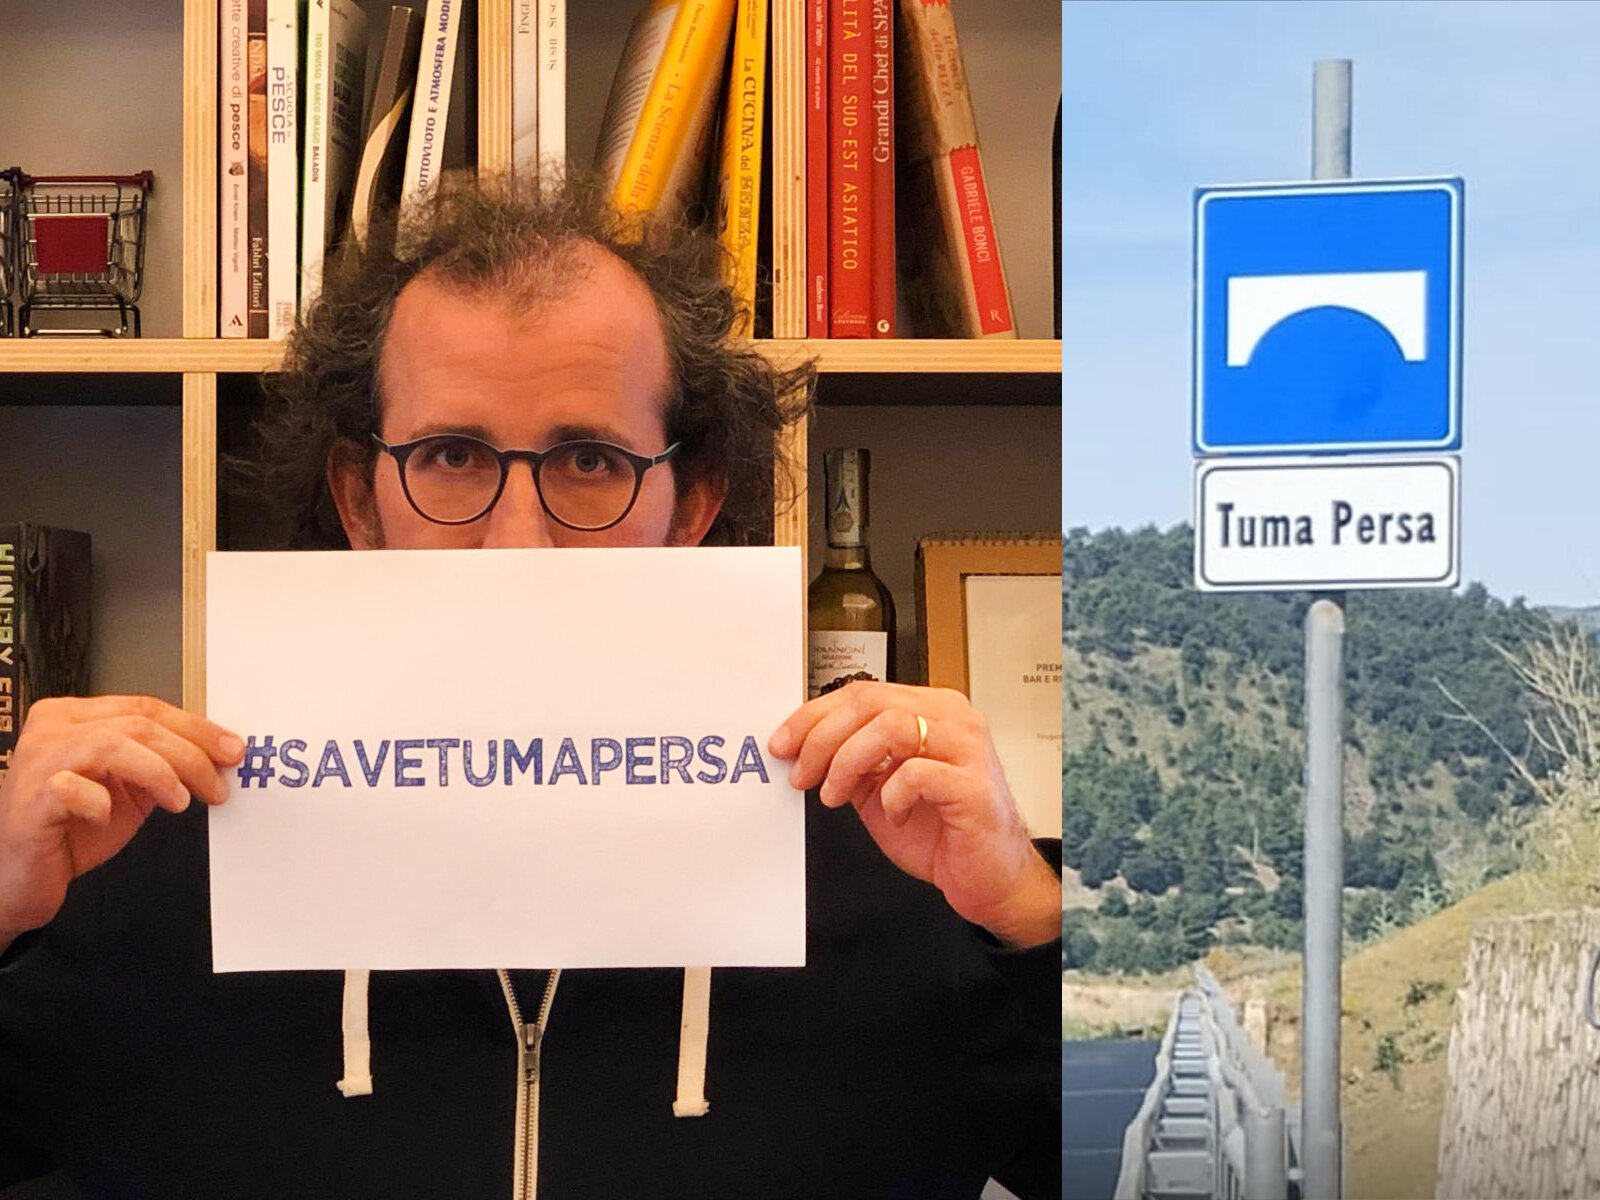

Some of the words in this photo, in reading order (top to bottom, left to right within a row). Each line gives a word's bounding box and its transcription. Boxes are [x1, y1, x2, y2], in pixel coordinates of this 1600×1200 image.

[231, 26, 242, 81] creative
[744, 58, 755, 72] La
[874, 35, 888, 49] di
[231, 85, 242, 99] di
[429, 36, 447, 103] ATMOSFERA
[664, 83, 681, 101] La
[842, 53, 858, 85] DEL
[872, 52, 889, 95] Chef
[229, 103, 241, 151] pesce
[272, 66, 285, 145] PESCE
[286, 82, 294, 128] SCUOLA
[428, 106, 438, 114] E
[741, 76, 757, 152] CUCINA
[644, 106, 674, 161] Scienza
[842, 95, 858, 171] SUD-EST
[872, 98, 890, 163] Grandi
[311, 145, 320, 183] BALADIN
[416, 117, 437, 194] SOTTOVUOTO
[740, 156, 751, 171] del
[630, 166, 653, 199] della
[842, 182, 858, 270] ASIATICO
[960, 165, 984, 224] GABRIELE
[972, 225, 991, 263] BONCI
[252, 236, 263, 269] Fabbri
[252, 271, 263, 308] Editori
[1216, 502, 1314, 547] Tuma
[1332, 500, 1436, 546] Persa
[1023, 675, 1042, 684] BAR
[1044, 675, 1051, 684] E
[237, 735, 770, 789] #SAVETUMAPERSA
